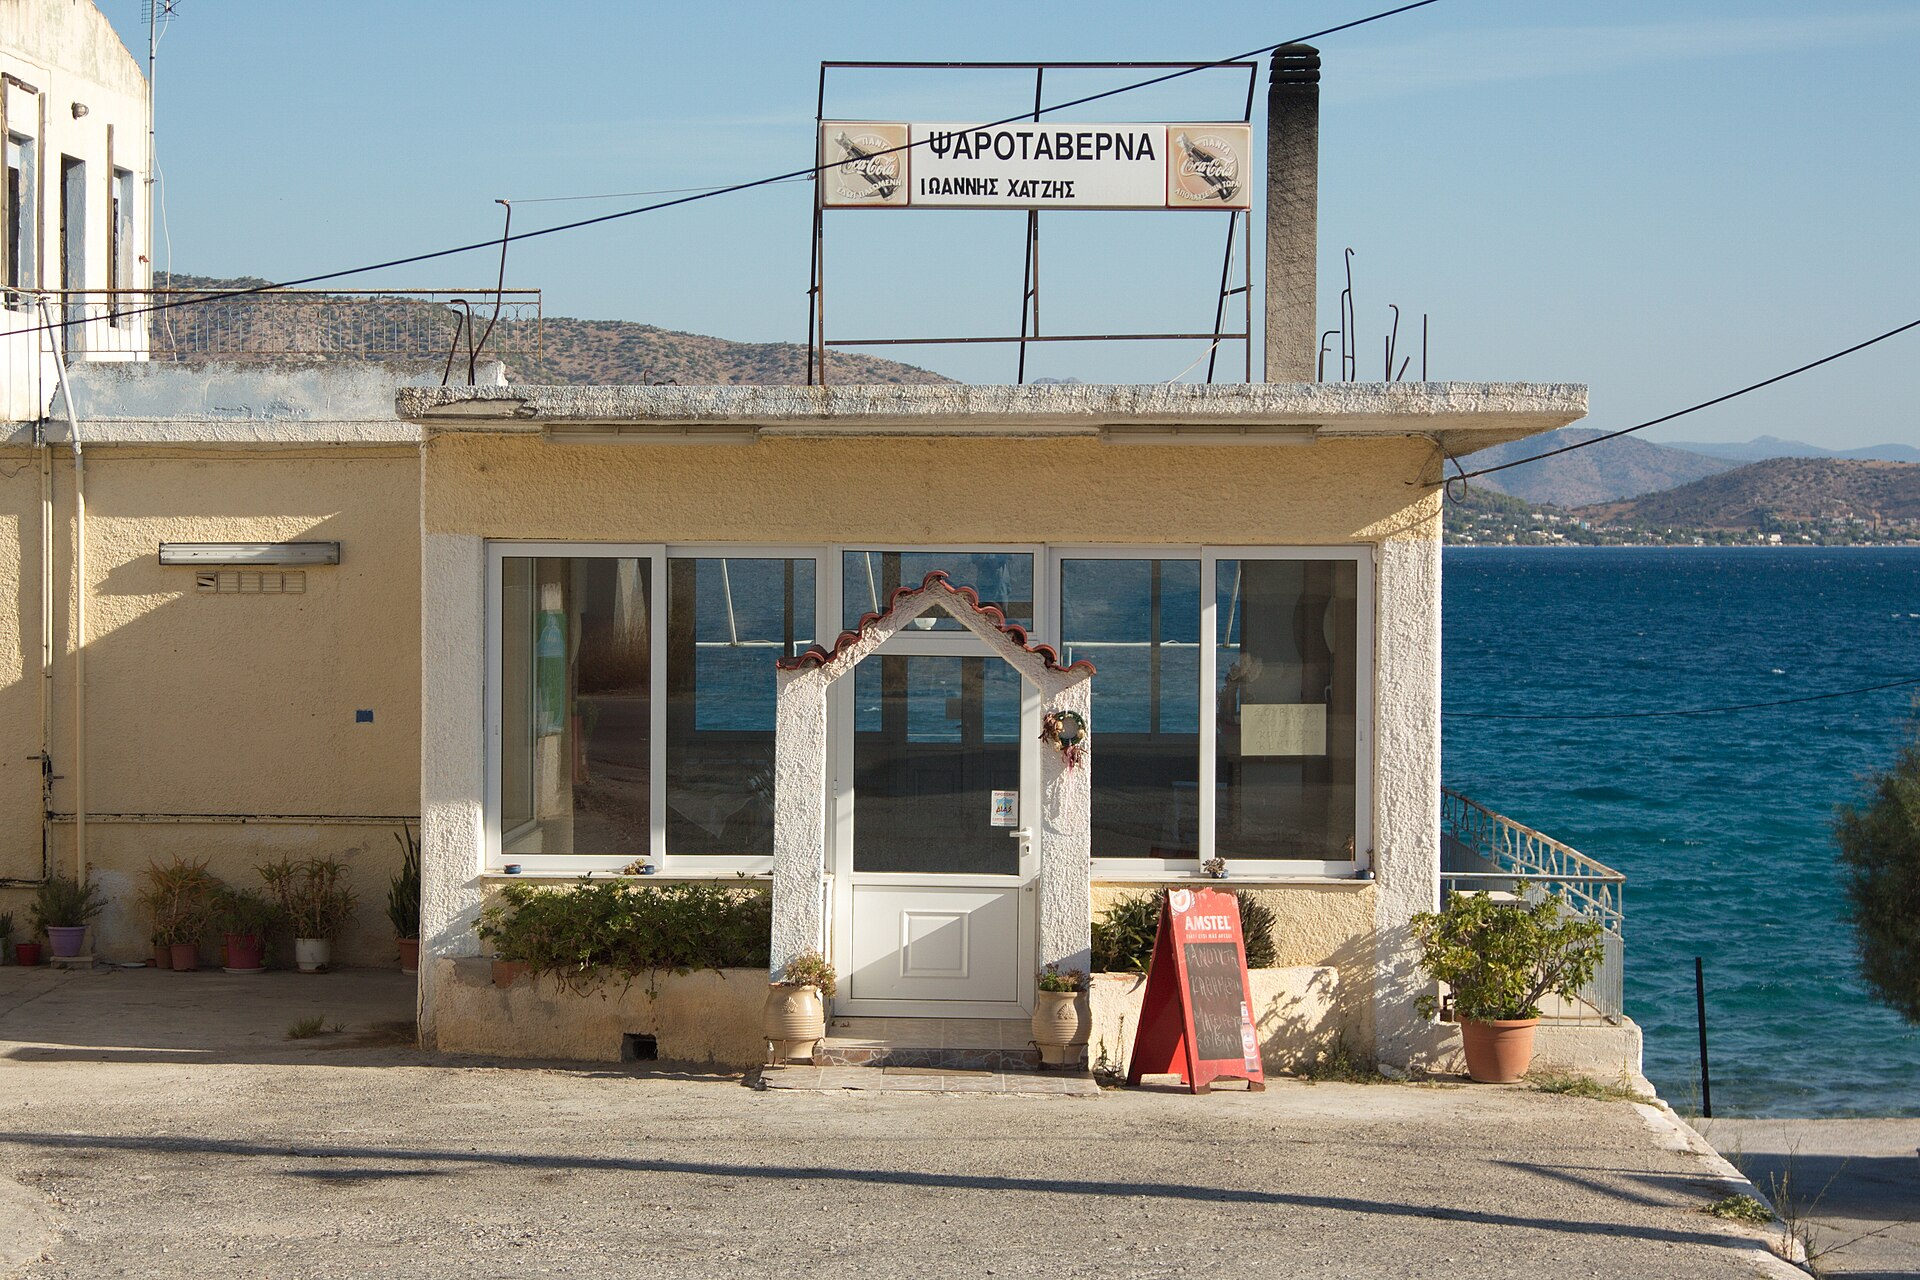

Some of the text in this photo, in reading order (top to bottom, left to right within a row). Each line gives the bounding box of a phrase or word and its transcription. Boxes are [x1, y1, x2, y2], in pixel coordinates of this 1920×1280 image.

[929, 131, 1156, 161] ΨΑΡΟΤΑΒΕΡΝΑ
[1202, 138, 1232, 156] ΠΑΝΤΑ
[840, 154, 898, 176] Coca-Cola
[1181, 157, 1236, 178] Coca-Cola
[920, 177, 1076, 199] ΙΩΑΝΝΗΣ ΧΑΤΖΗΣ
[1184, 915, 1232, 931] AMSTEL
